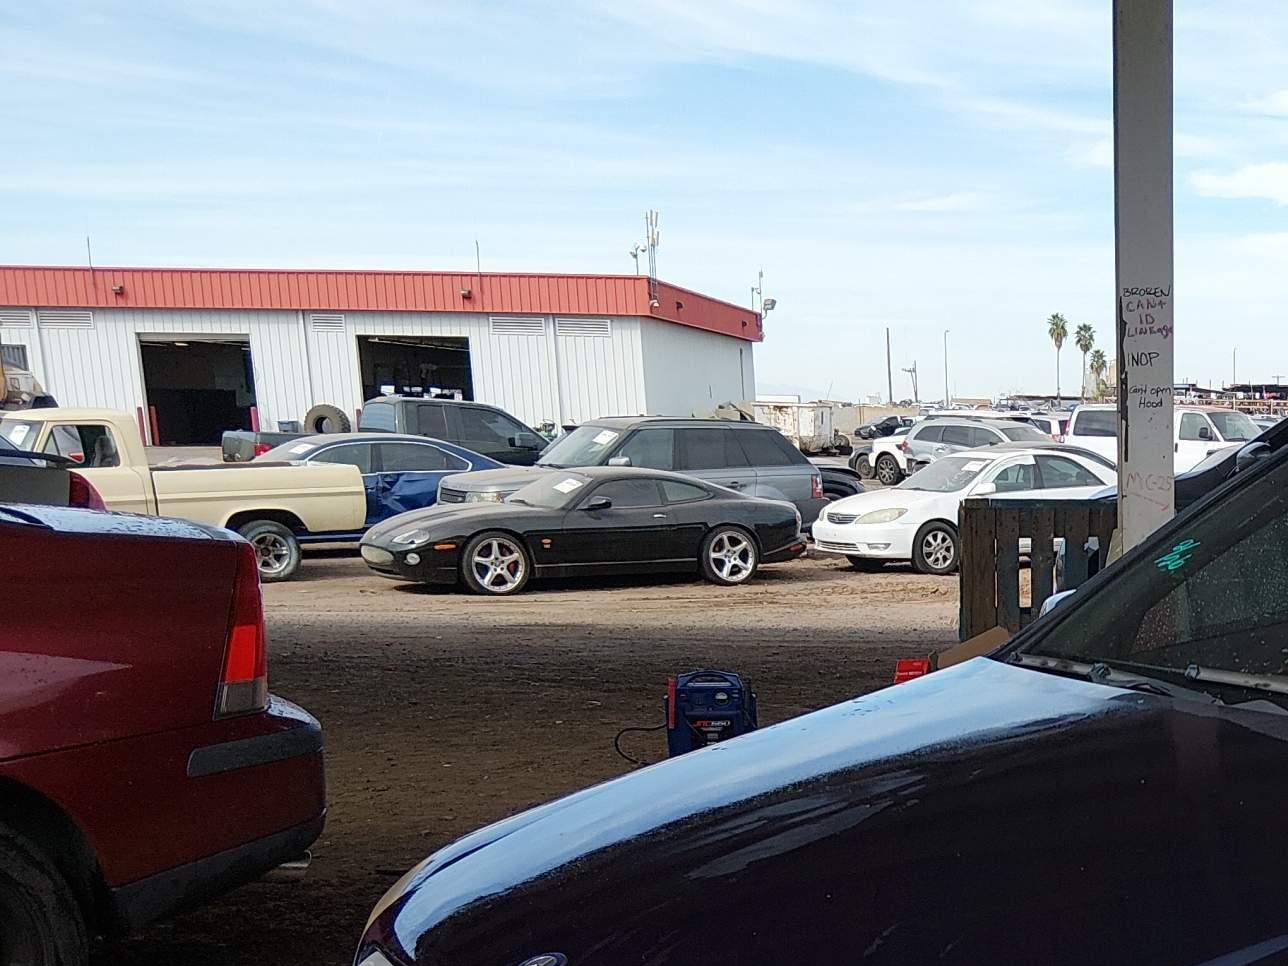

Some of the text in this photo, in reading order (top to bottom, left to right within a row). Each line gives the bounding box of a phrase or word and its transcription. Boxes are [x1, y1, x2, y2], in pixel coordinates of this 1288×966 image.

[1123, 285, 1171, 297] BROKEN
[1139, 313, 1155, 325] ID
[1127, 351, 1160, 367] INOP
[1138, 397, 1163, 409] Hood
